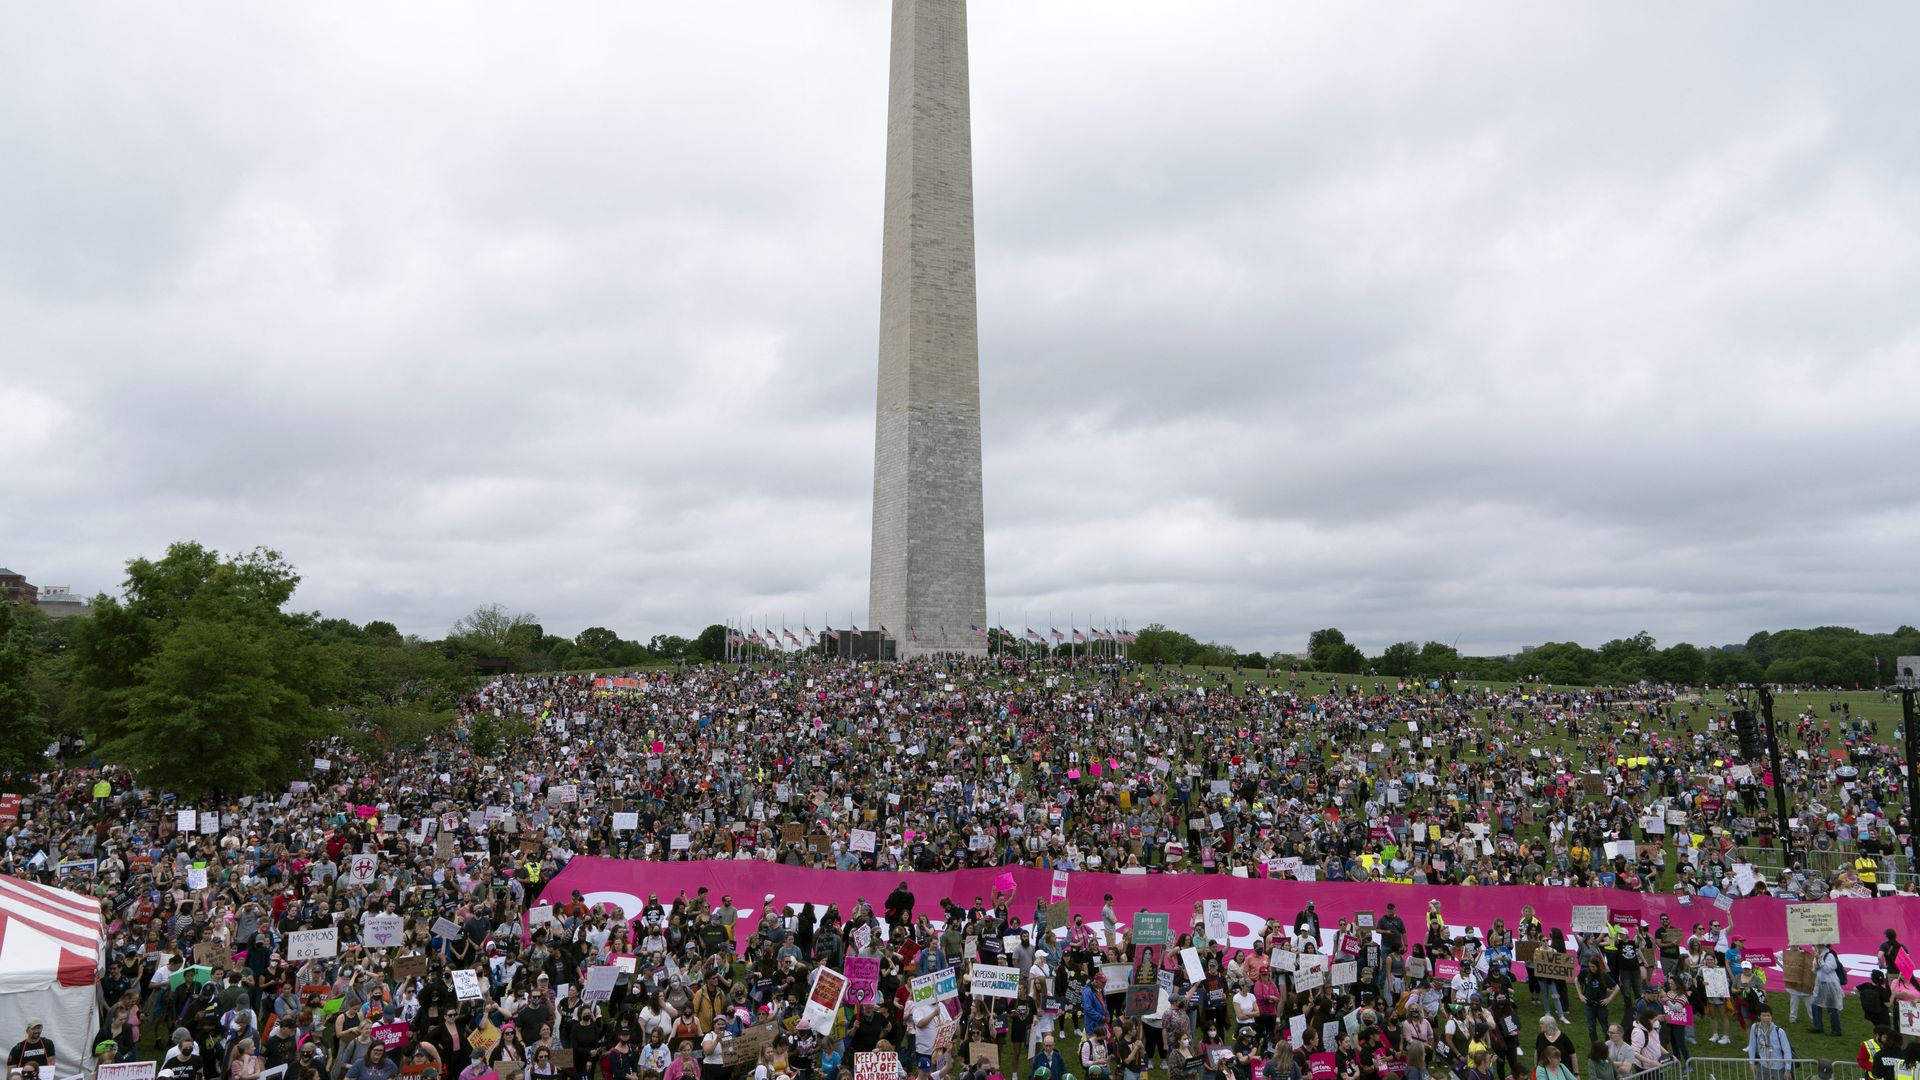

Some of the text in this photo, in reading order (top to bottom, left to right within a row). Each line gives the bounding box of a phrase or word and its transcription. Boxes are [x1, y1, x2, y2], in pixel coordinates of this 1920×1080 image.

[292, 930, 334, 943] MORMONS
[297, 948, 320, 957] ROE
[1547, 952, 1562, 964] WE
[935, 968, 954, 979] THEIR
[1537, 963, 1574, 978] DISSENT
[913, 977, 932, 987] THEIR
[980, 971, 997, 979] PERSON
[999, 972, 1005, 980] IS
[1006, 973, 1019, 982] FREE
[972, 980, 1018, 990] WITHOUT AUTONOMY
[384, 1036, 400, 1045] DIES
[387, 1031, 402, 1039] OUR
[855, 1052, 897, 1064] KEEP YOUR
[855, 1062, 897, 1073] LAWS OFF
